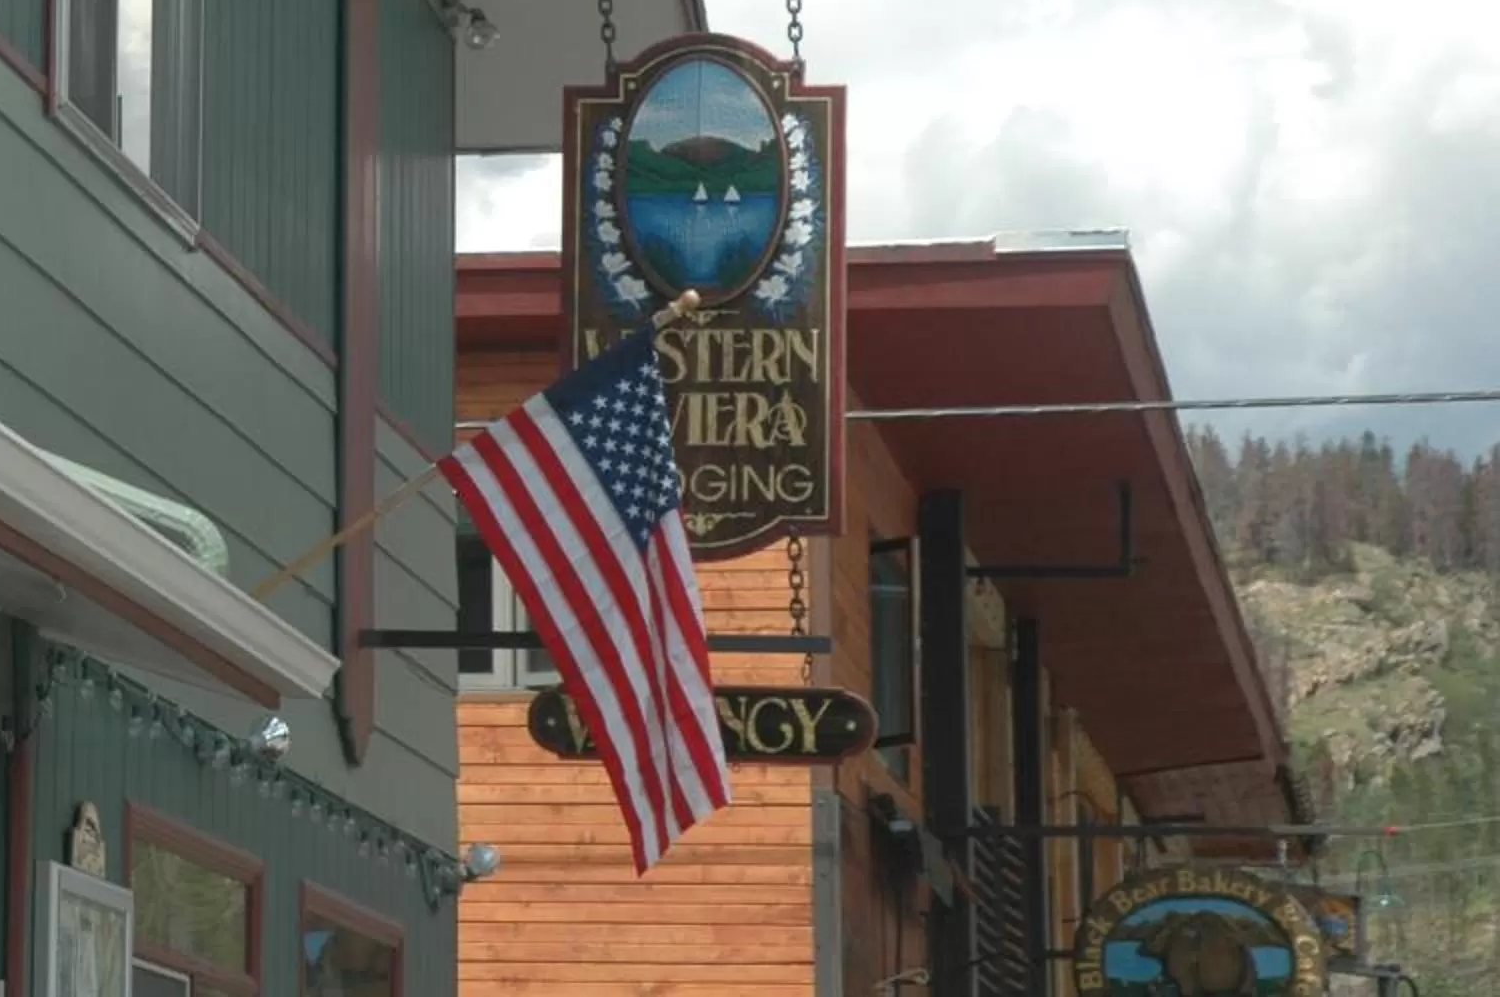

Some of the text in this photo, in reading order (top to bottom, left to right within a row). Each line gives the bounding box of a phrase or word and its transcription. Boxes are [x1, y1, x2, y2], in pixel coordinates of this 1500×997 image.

[585, 328, 820, 385] STERN
[671, 389, 808, 449] IERA
[678, 464, 814, 502] GING
[1076, 919, 1114, 989] Black
[1108, 876, 1169, 915] Bear
[1176, 869, 1273, 907] Bakery
